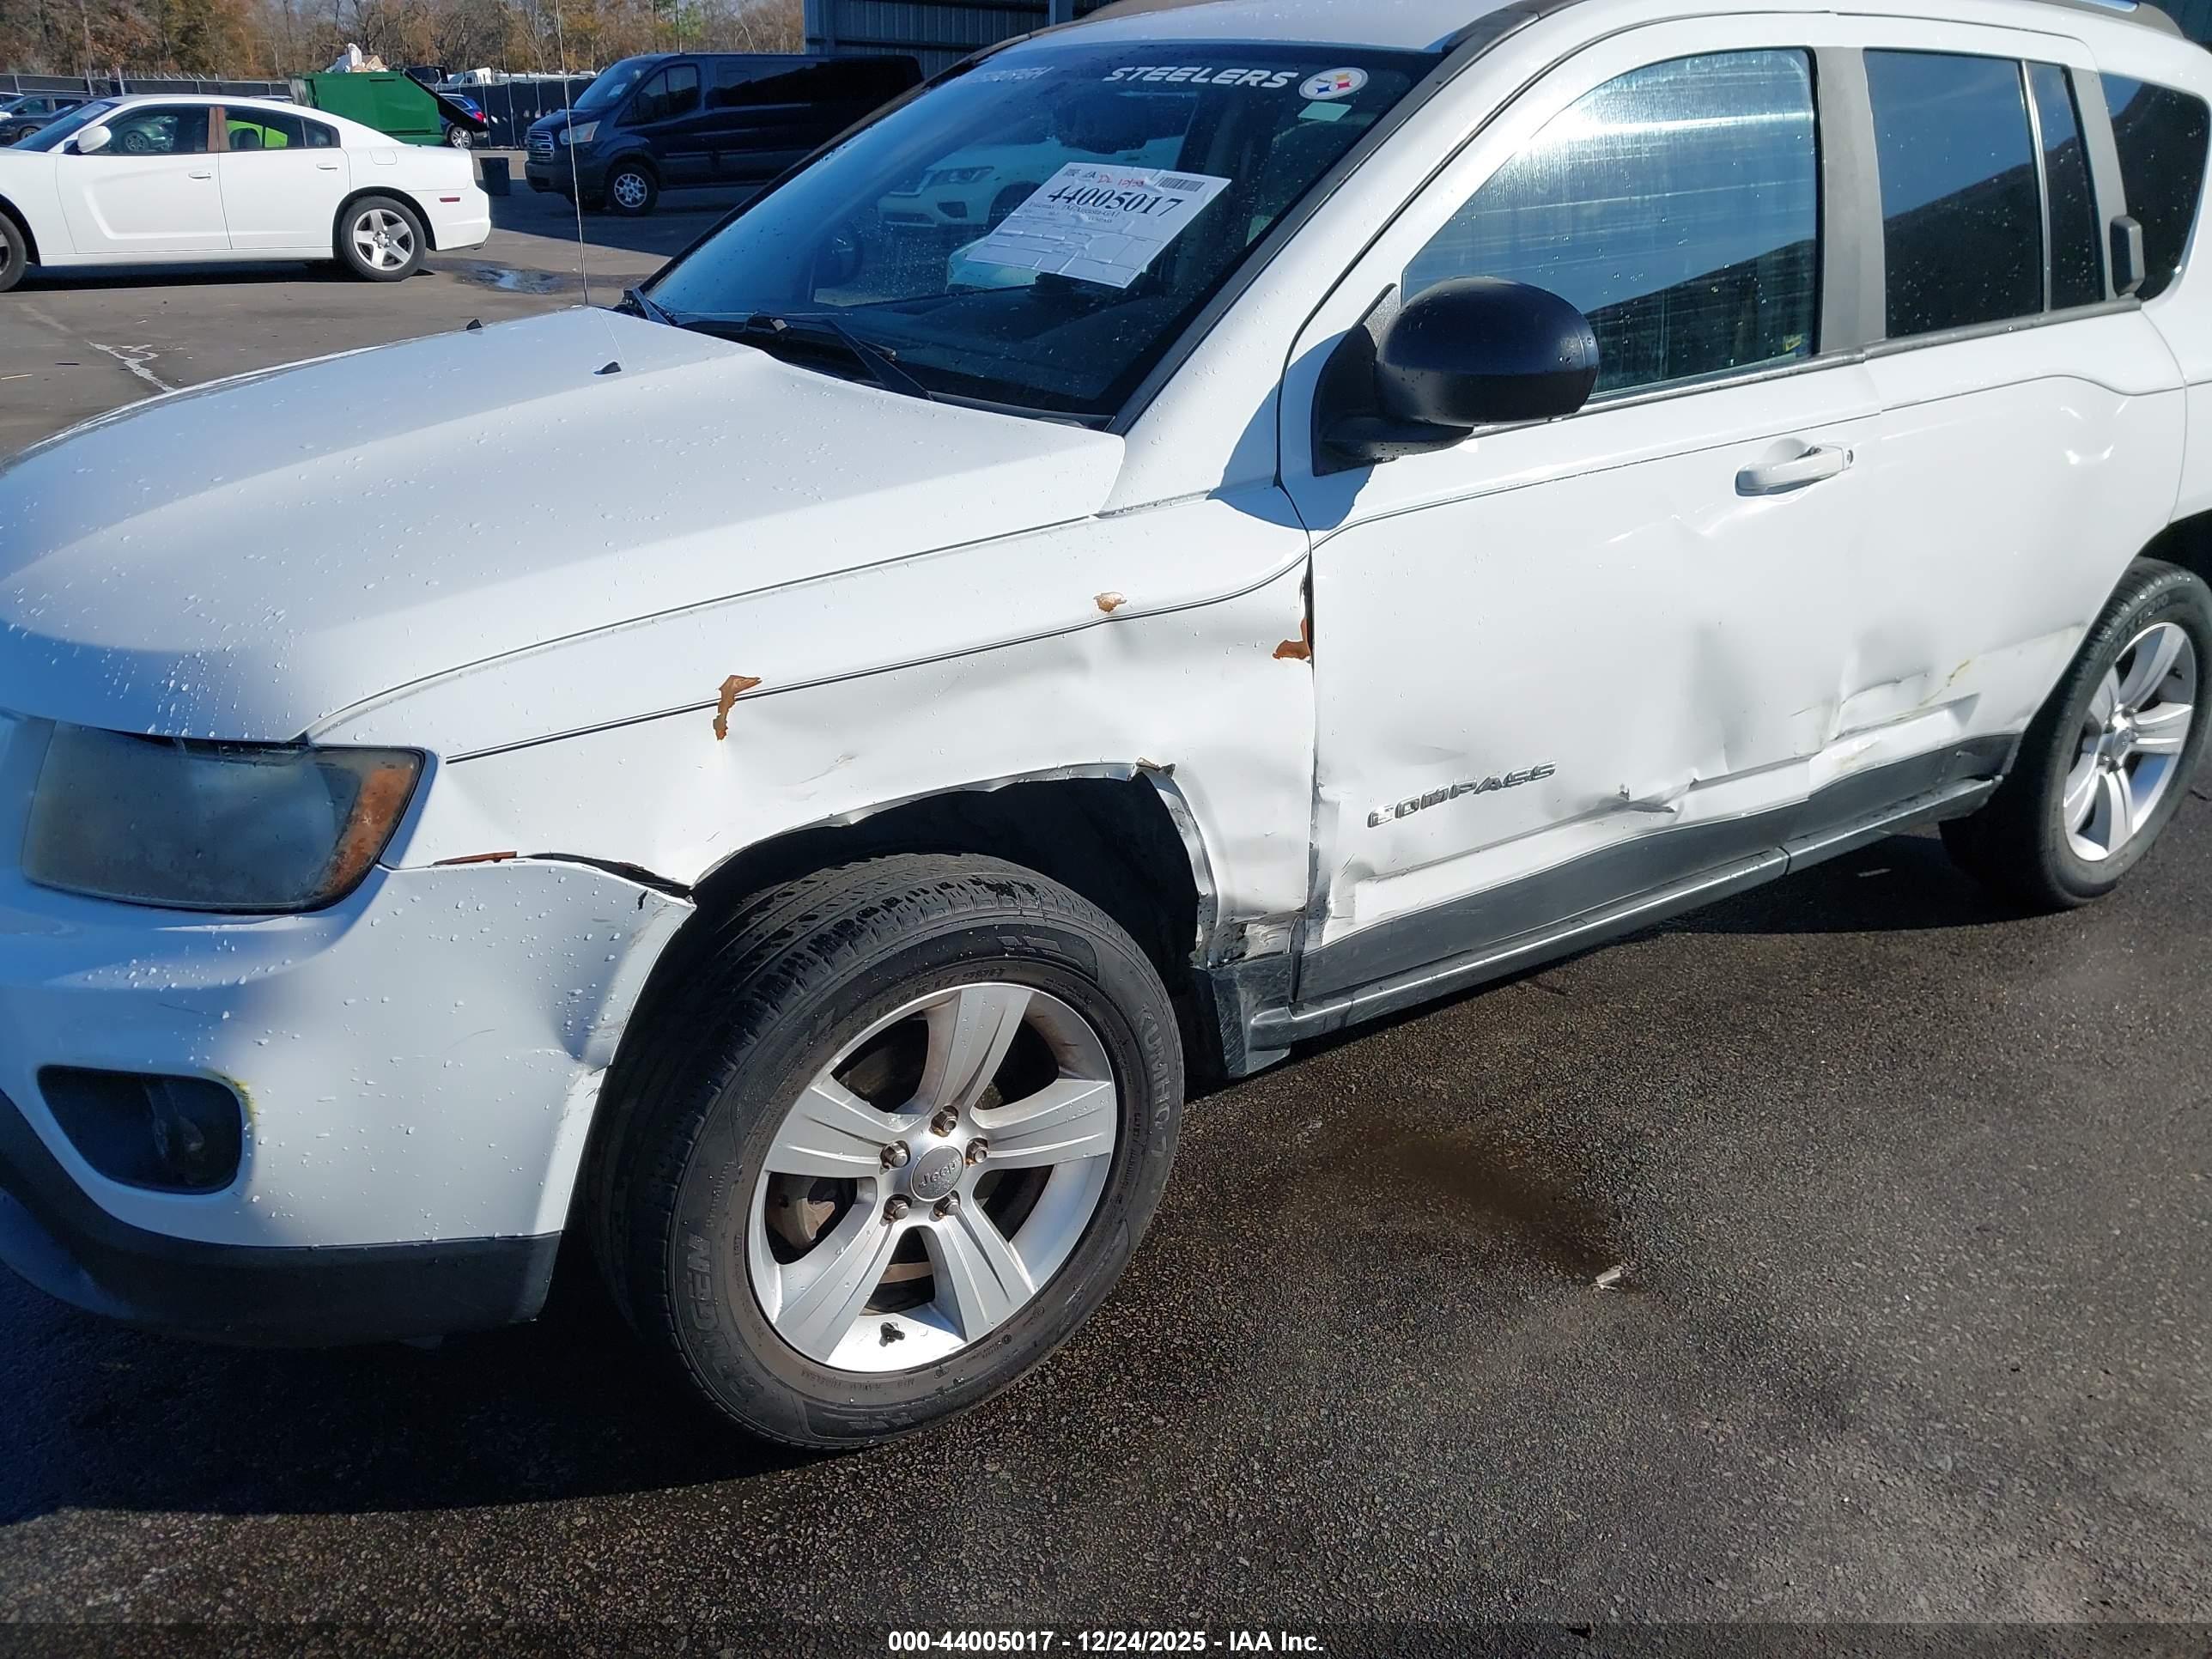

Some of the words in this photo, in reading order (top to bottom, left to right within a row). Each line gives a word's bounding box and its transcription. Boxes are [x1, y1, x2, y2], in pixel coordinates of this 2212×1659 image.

[1103, 66, 1299, 88] STEELERS
[1047, 184, 1185, 218] 44005017
[1367, 760, 1557, 829] COMPASS
[918, 1158, 960, 1189] Jeep
